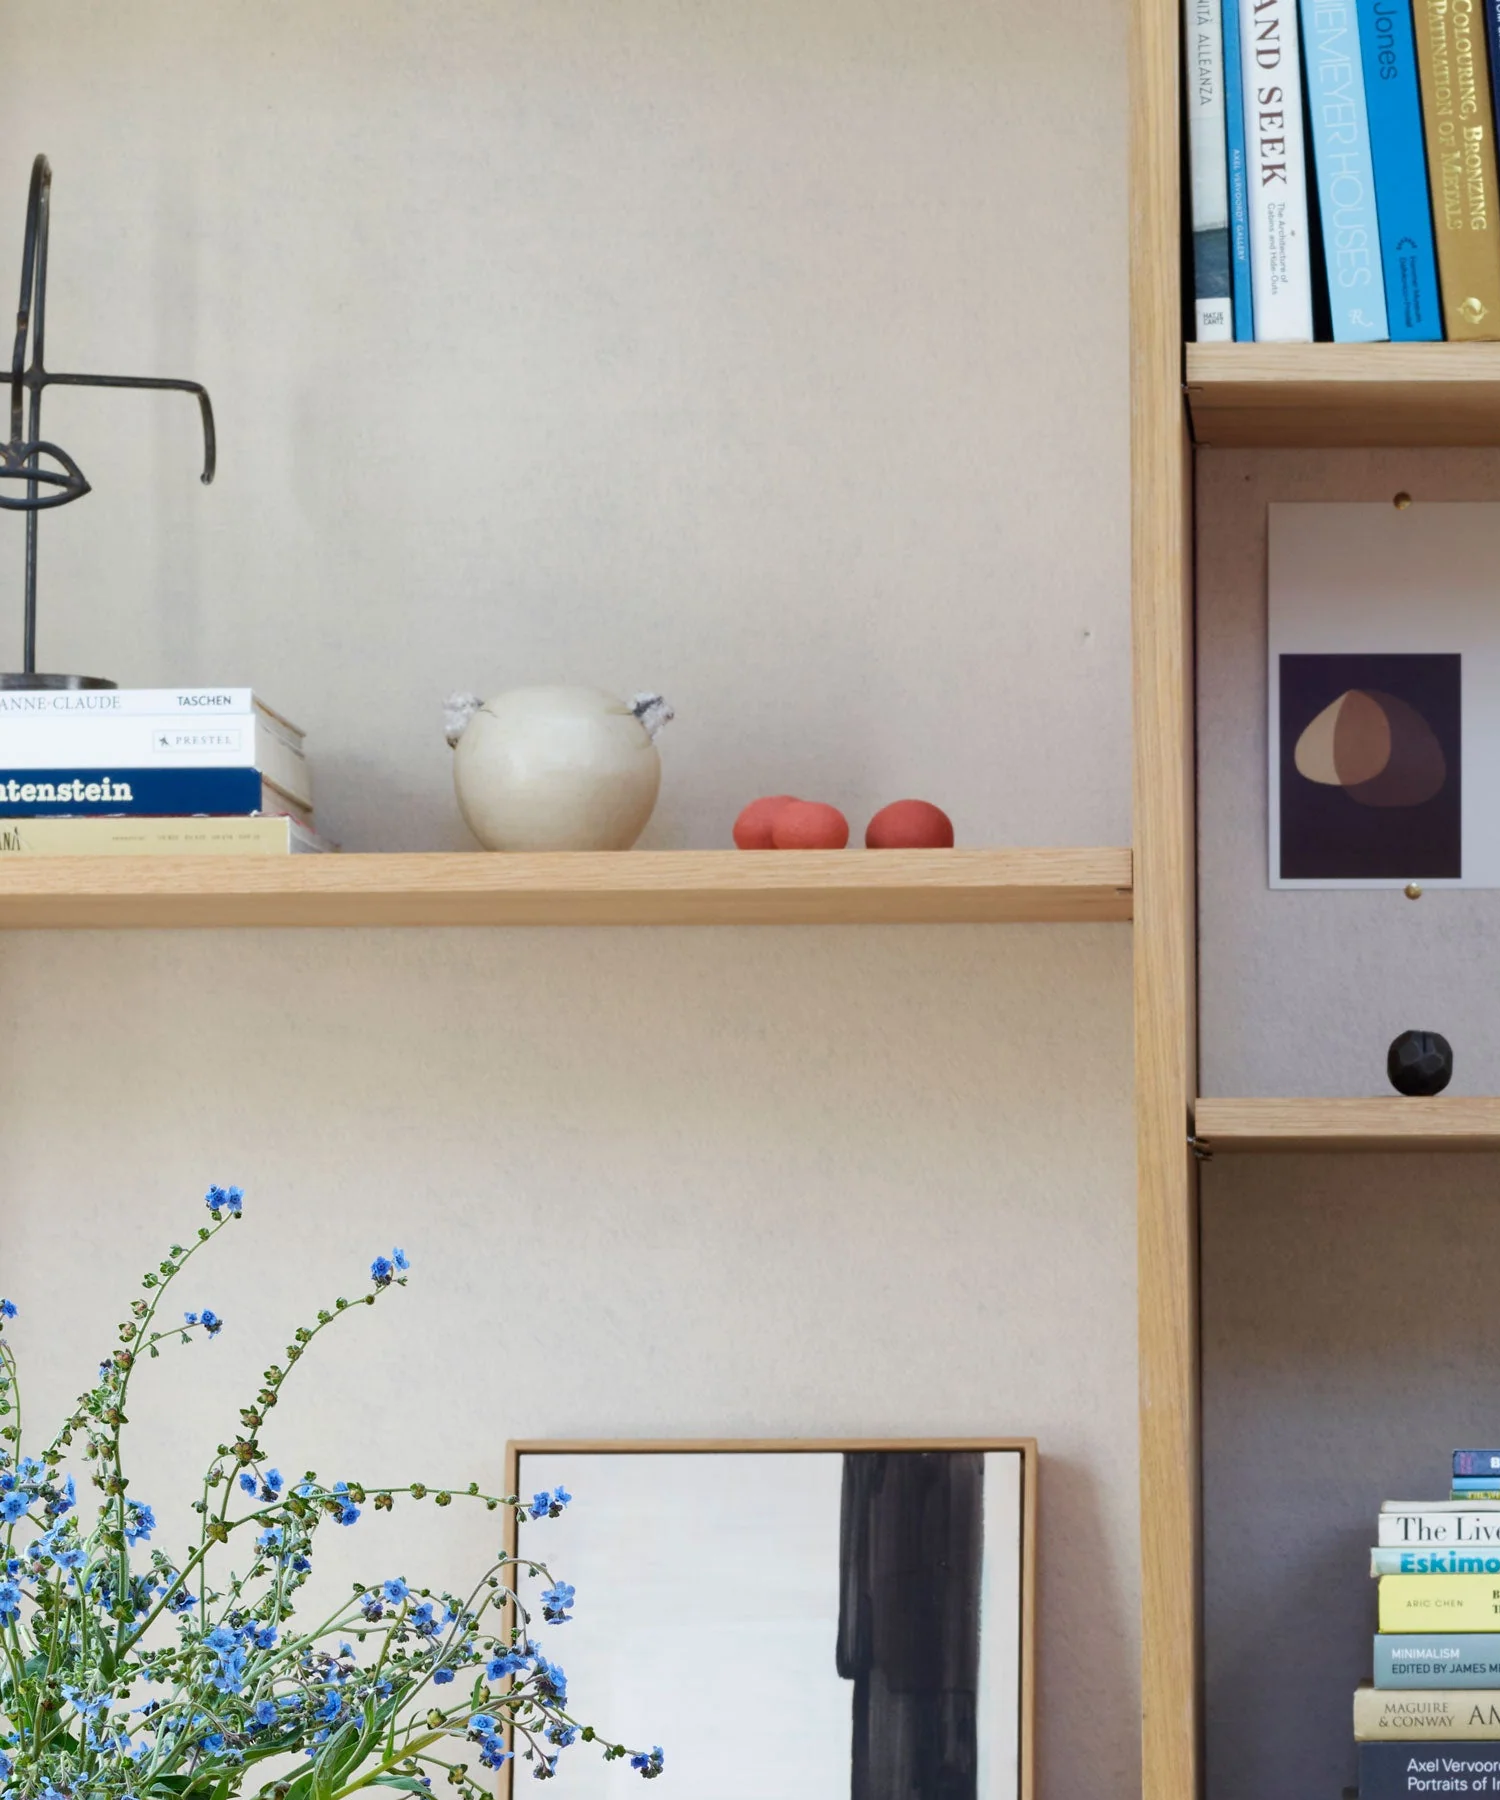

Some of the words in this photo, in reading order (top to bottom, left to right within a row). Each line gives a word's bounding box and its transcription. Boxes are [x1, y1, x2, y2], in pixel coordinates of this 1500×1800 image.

[1373, 1, 1398, 80] Jones
[1428, 0, 1453, 115] PATINATION
[1452, 0, 1477, 120] COLOURING,
[1198, 34, 1212, 106] ALLEANZA
[1258, 86, 1287, 187] SEEK
[1439, 122, 1455, 146] OF
[1464, 125, 1486, 230] BRONZING
[1441, 151, 1462, 230] METALS
[1328, 152, 1372, 288] HOUSES
[1278, 221, 1287, 273] Architecture
[1281, 274, 1288, 283] of
[177, 695, 232, 707] TASCHEN
[176, 736, 232, 745] PRESTEL
[1397, 1516, 1447, 1541] The
[1401, 1551, 1500, 1573] Eskimo
[1406, 1600, 1430, 1608] ARIC
[1434, 1599, 1464, 1608] CHEN
[1391, 1648, 1460, 1660] MINIMALISM
[1391, 1663, 1431, 1674] EDITED
[1433, 1663, 1447, 1674] BY
[1450, 1663, 1487, 1674] JAMES
[1384, 1702, 1449, 1714] MAGUIRE
[1378, 1717, 1389, 1728] &
[1392, 1715, 1454, 1728] CONWAY
[1407, 1758, 1439, 1772] Axel
[1408, 1777, 1468, 1791] Portraits
[1472, 1777, 1488, 1791] of
